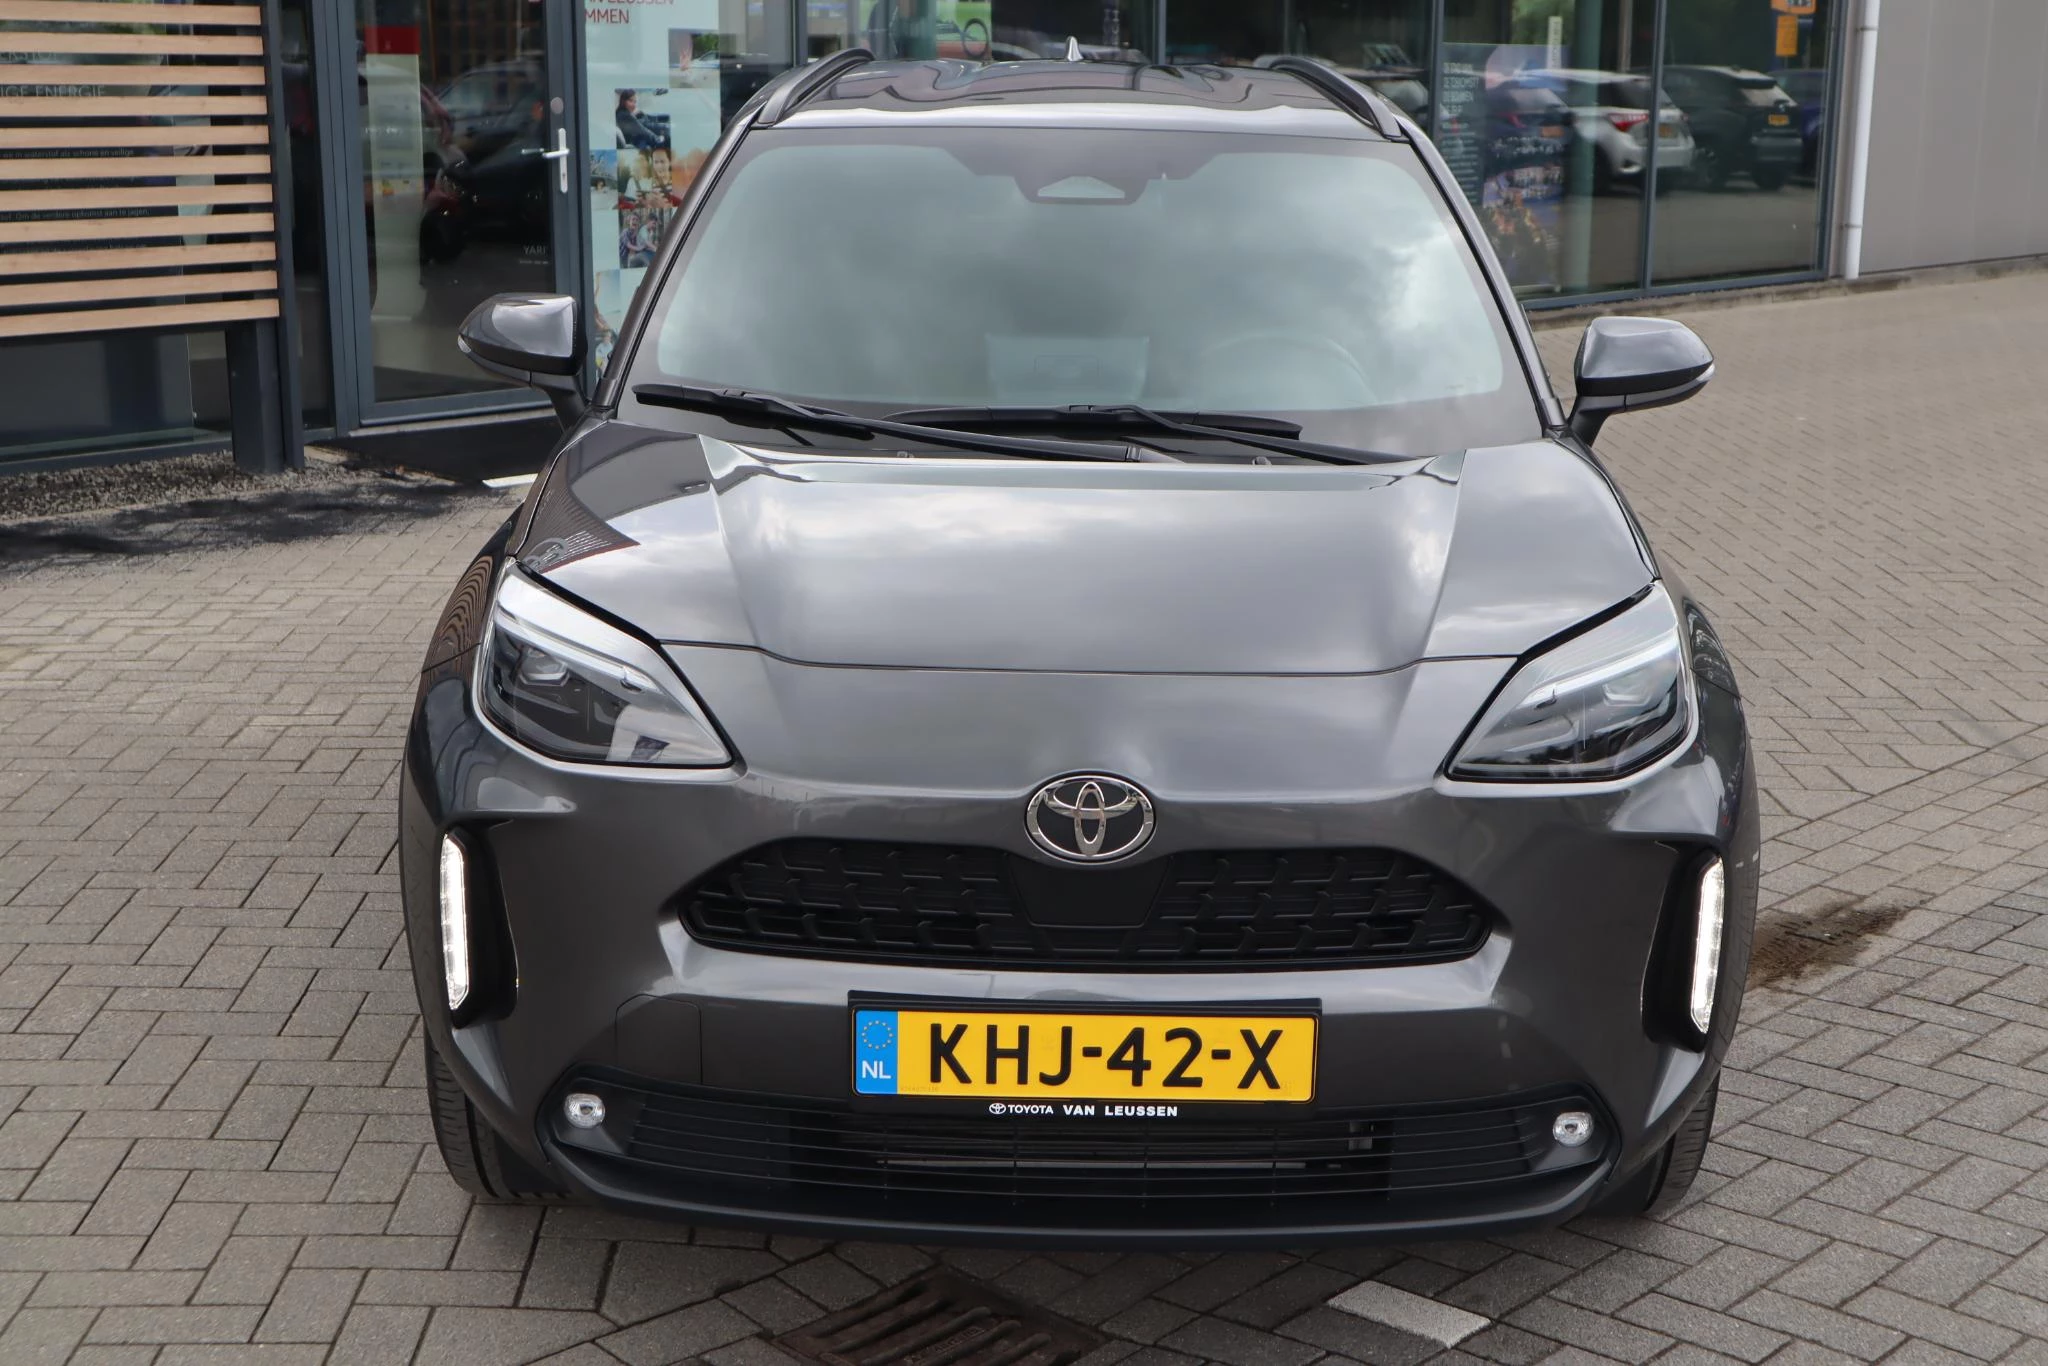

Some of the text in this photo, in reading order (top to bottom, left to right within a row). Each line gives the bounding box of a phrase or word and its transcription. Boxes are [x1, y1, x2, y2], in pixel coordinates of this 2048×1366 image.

[930, 1023, 1284, 1090] KHJ-42-X
[862, 1060, 891, 1080] NL
[1008, 1104, 1178, 1117] TOYOTA VAN LEUSSEN
